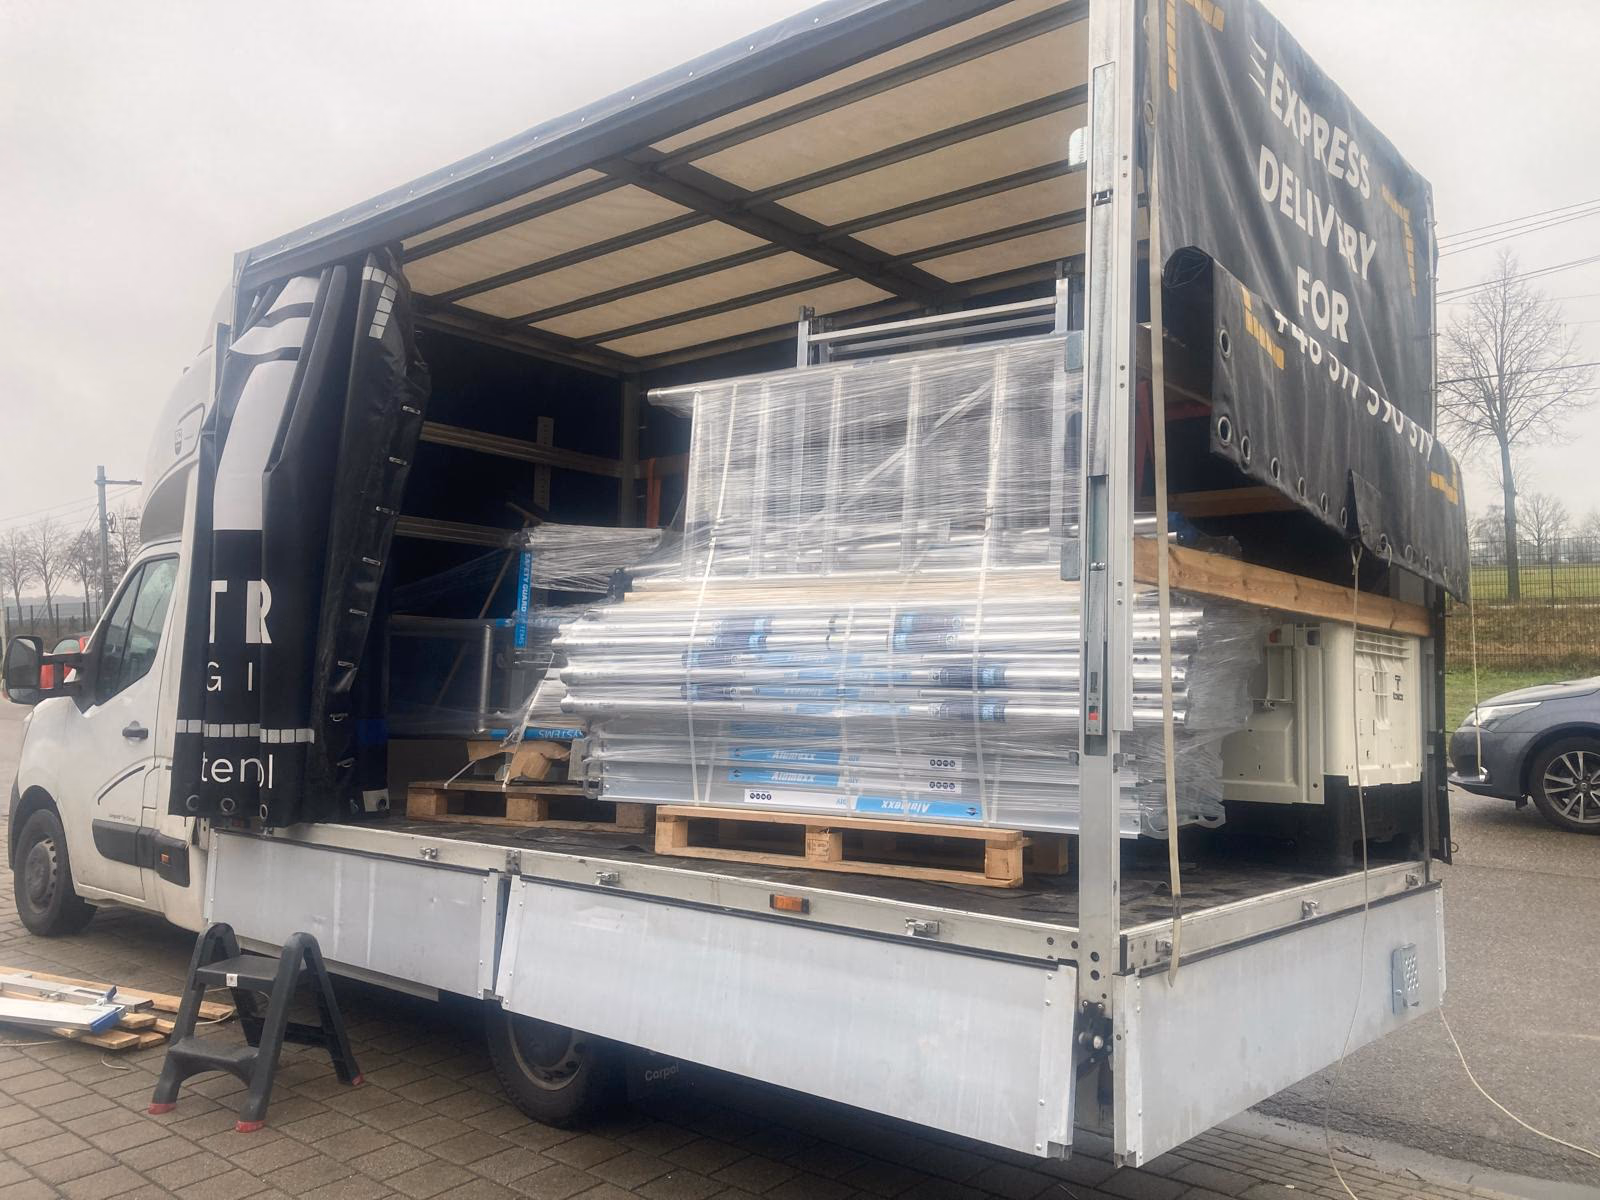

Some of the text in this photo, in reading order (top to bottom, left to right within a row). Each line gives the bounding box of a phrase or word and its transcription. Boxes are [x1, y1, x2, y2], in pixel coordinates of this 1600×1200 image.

[1270, 61, 1370, 199] EXPRESS
[1296, 265, 1349, 344] FOR
[521, 583, 529, 612] GUARD
